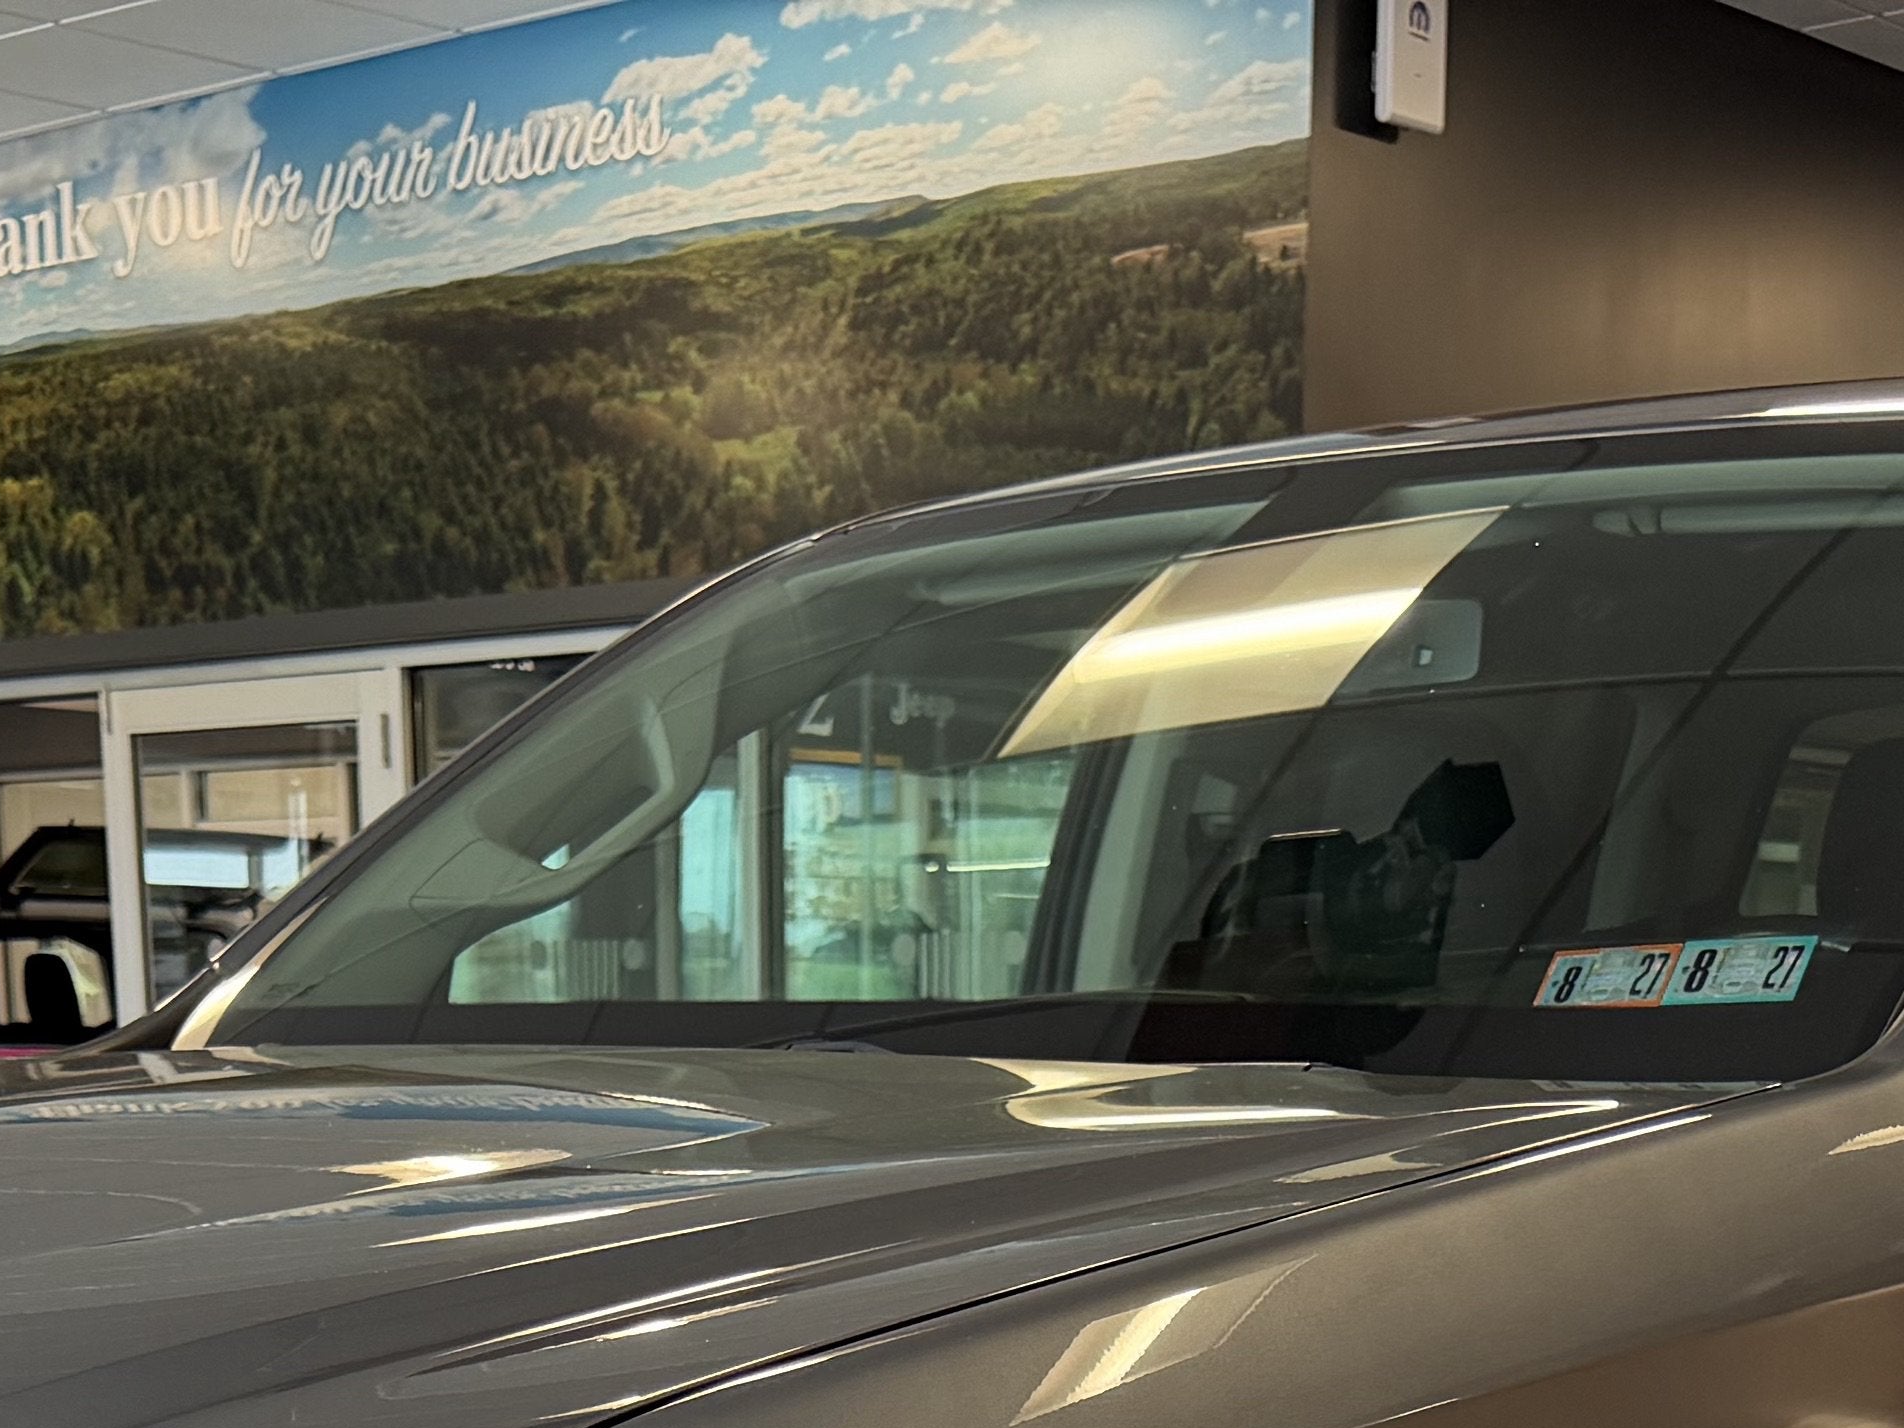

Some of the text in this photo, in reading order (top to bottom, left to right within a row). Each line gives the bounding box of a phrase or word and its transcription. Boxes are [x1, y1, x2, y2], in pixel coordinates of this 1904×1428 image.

[111, 177, 224, 278] you
[230, 147, 308, 268] for
[308, 140, 437, 262] your
[447, 94, 673, 191] business
[888, 682, 956, 727] Jeep
[1555, 953, 1671, 1003] 8 27
[1684, 945, 1805, 992] 8 27
